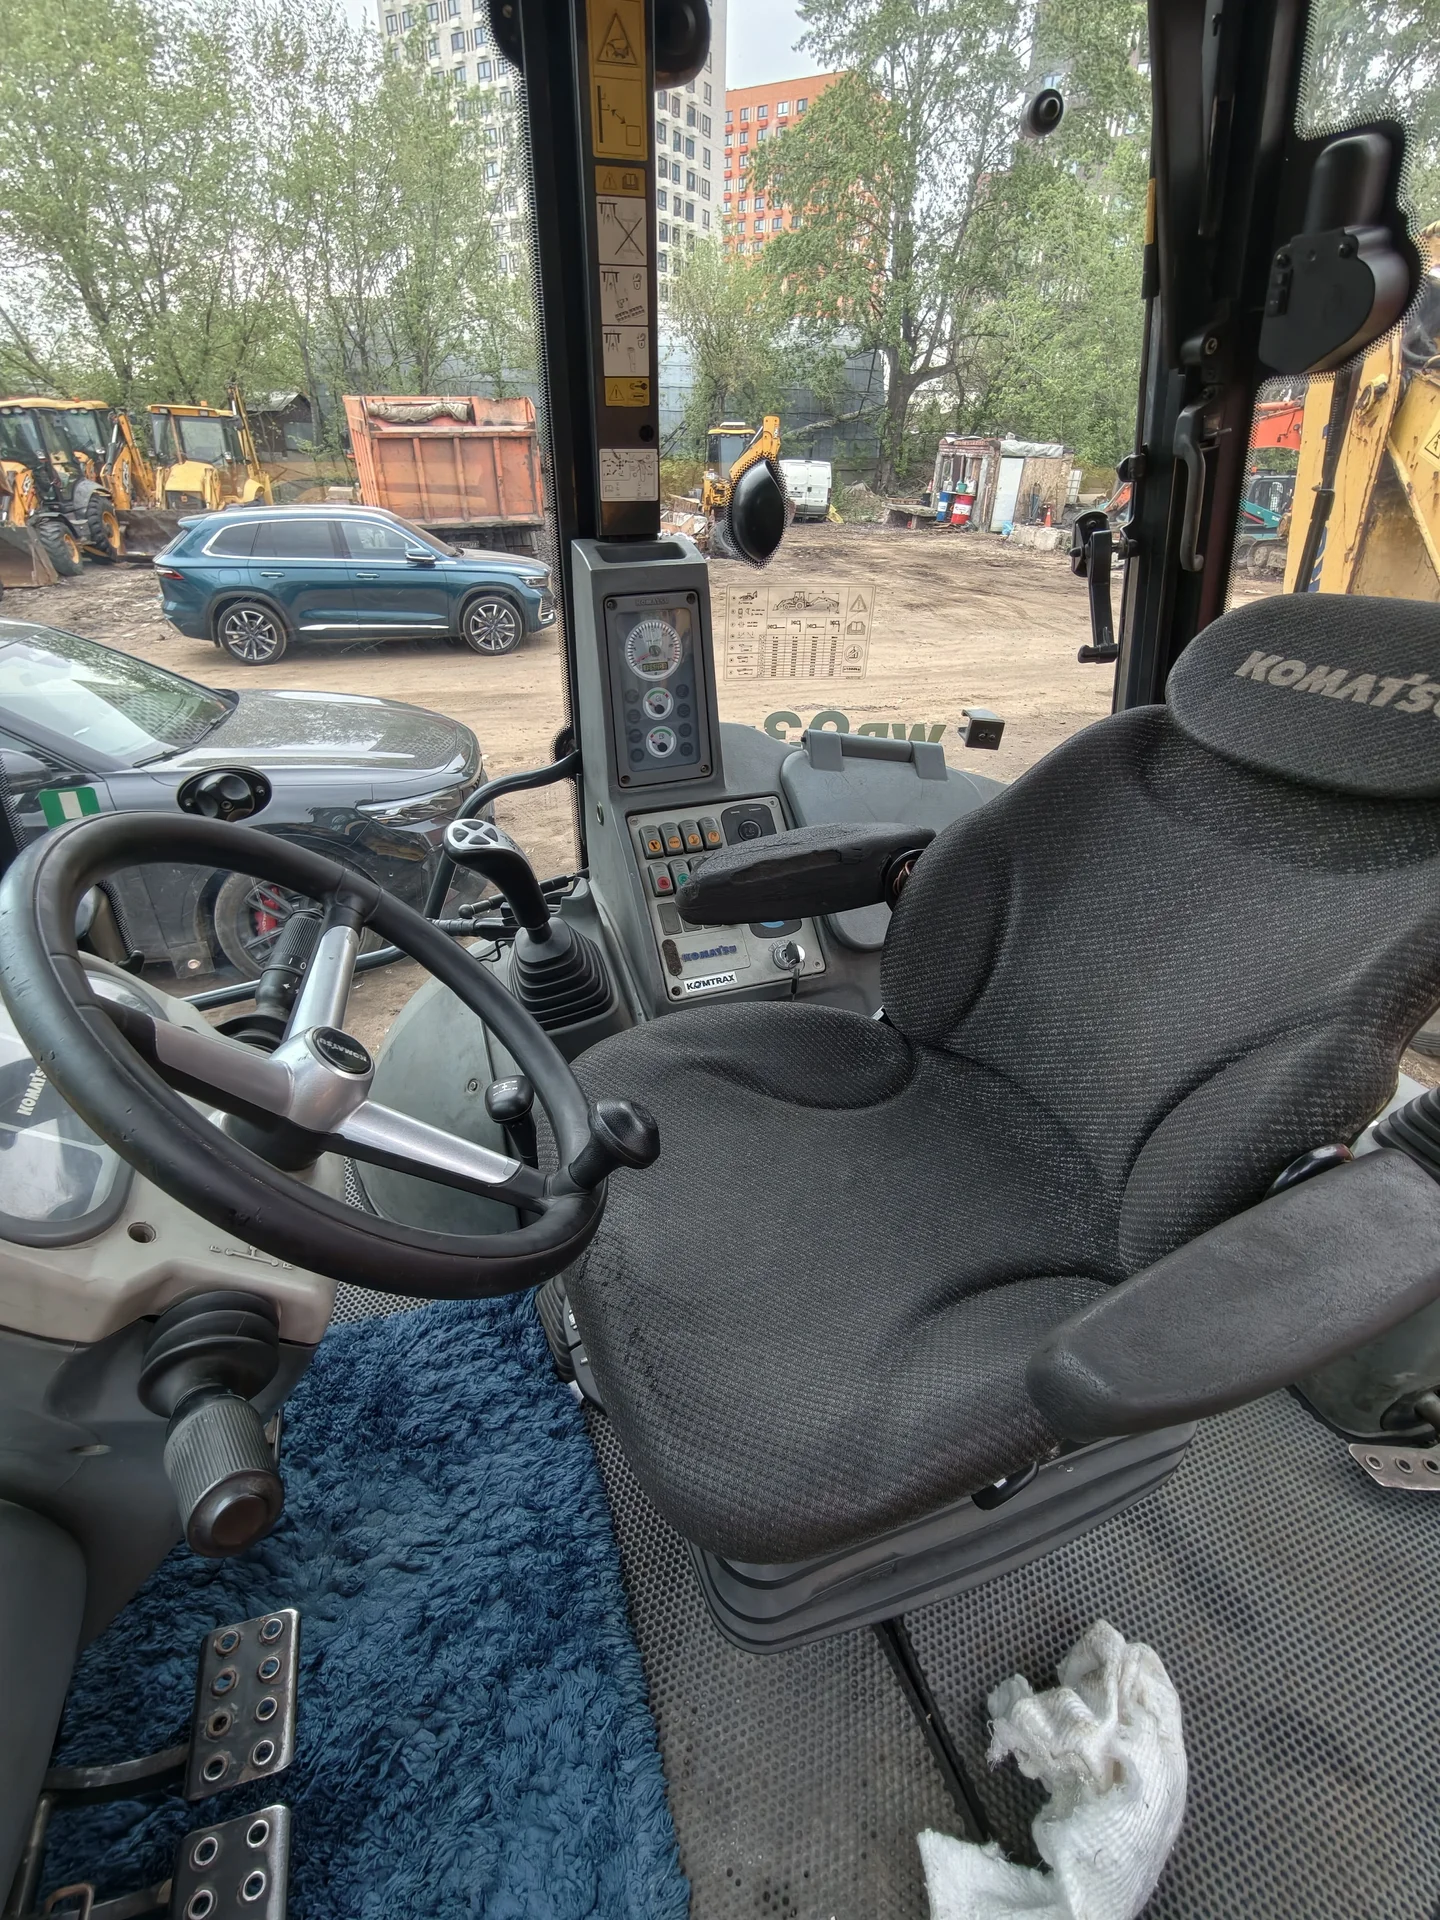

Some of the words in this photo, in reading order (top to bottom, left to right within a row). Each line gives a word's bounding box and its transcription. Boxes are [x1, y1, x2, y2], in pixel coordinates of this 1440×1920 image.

[1234, 651, 1440, 718] KOMATS
[681, 945, 737, 962] KOMATSU
[686, 974, 735, 991] KOMTRAX
[16, 1066, 47, 1116] KOMATS
